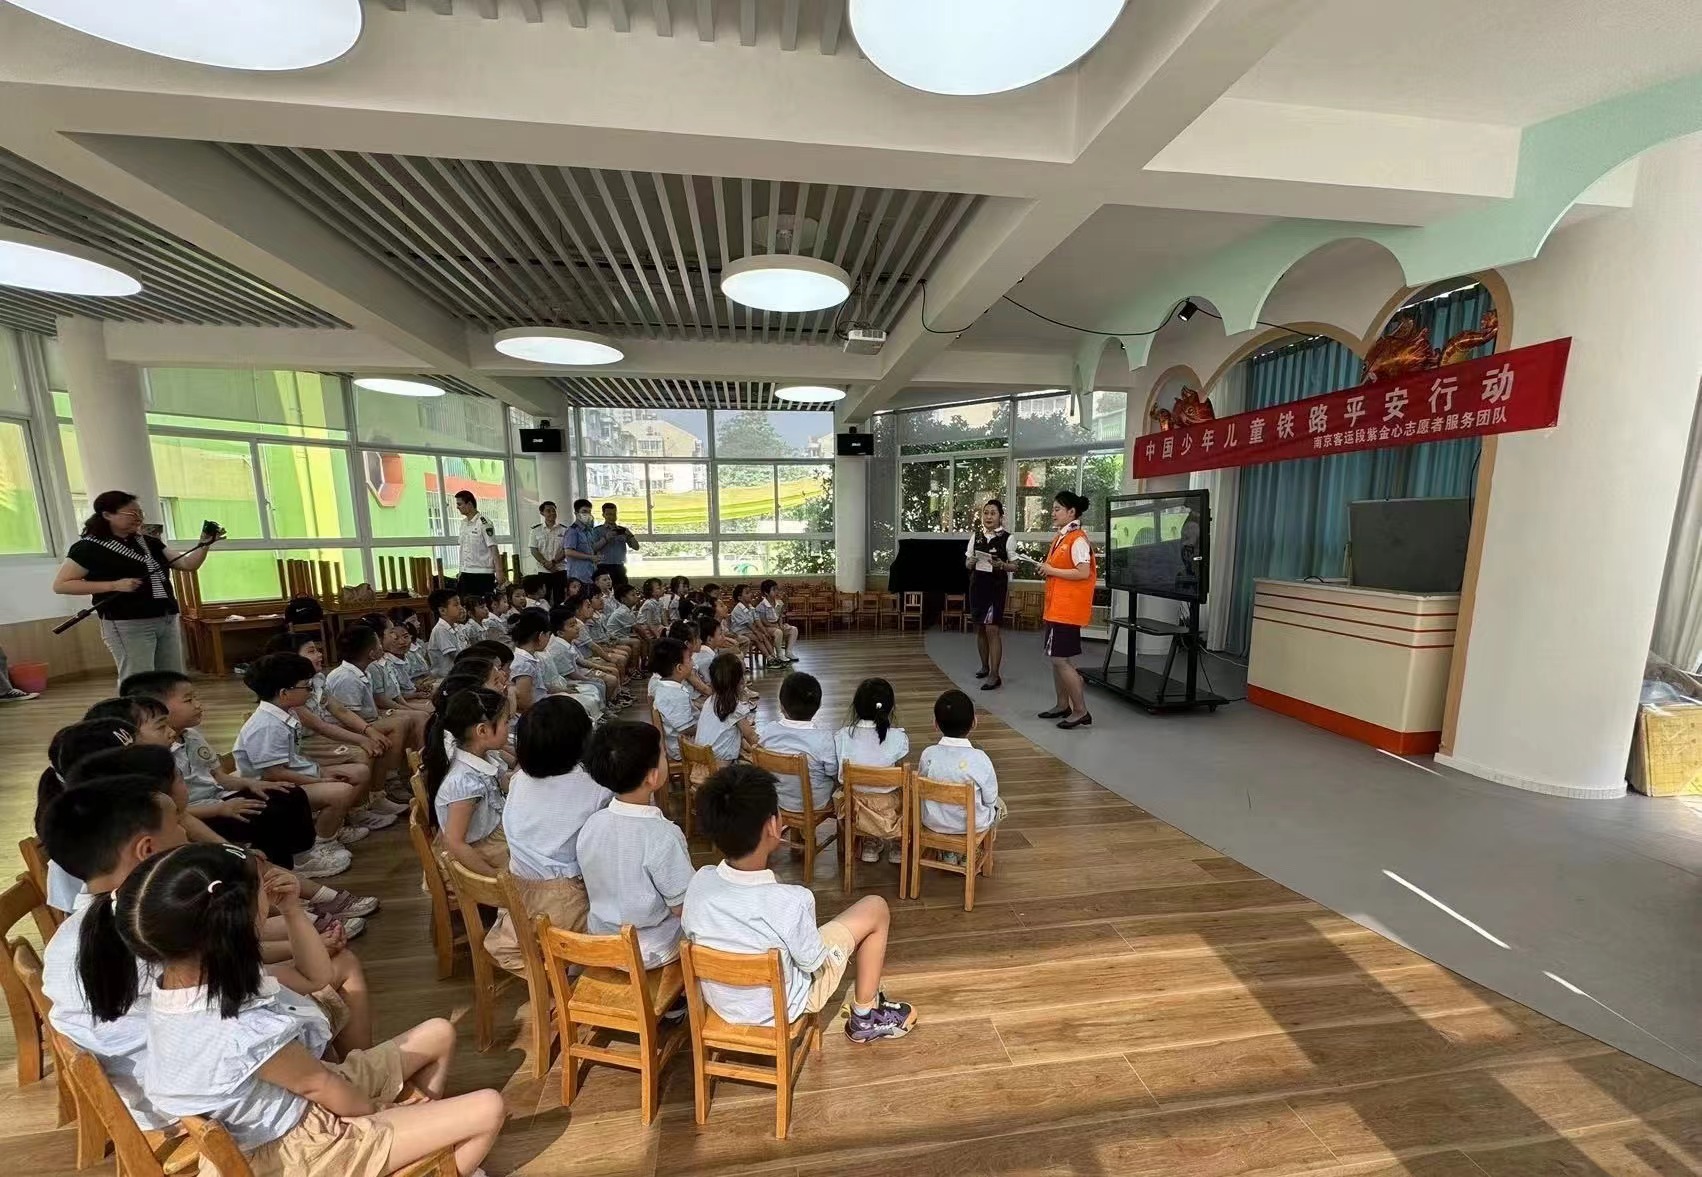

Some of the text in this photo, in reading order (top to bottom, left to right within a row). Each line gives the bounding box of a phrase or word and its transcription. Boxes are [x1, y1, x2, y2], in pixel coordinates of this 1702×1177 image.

[1145, 362, 1515, 462] 中国少年儿童铁路平安行动
[1313, 406, 1508, 449] 南京客运段紫金心志愿者服务团队
